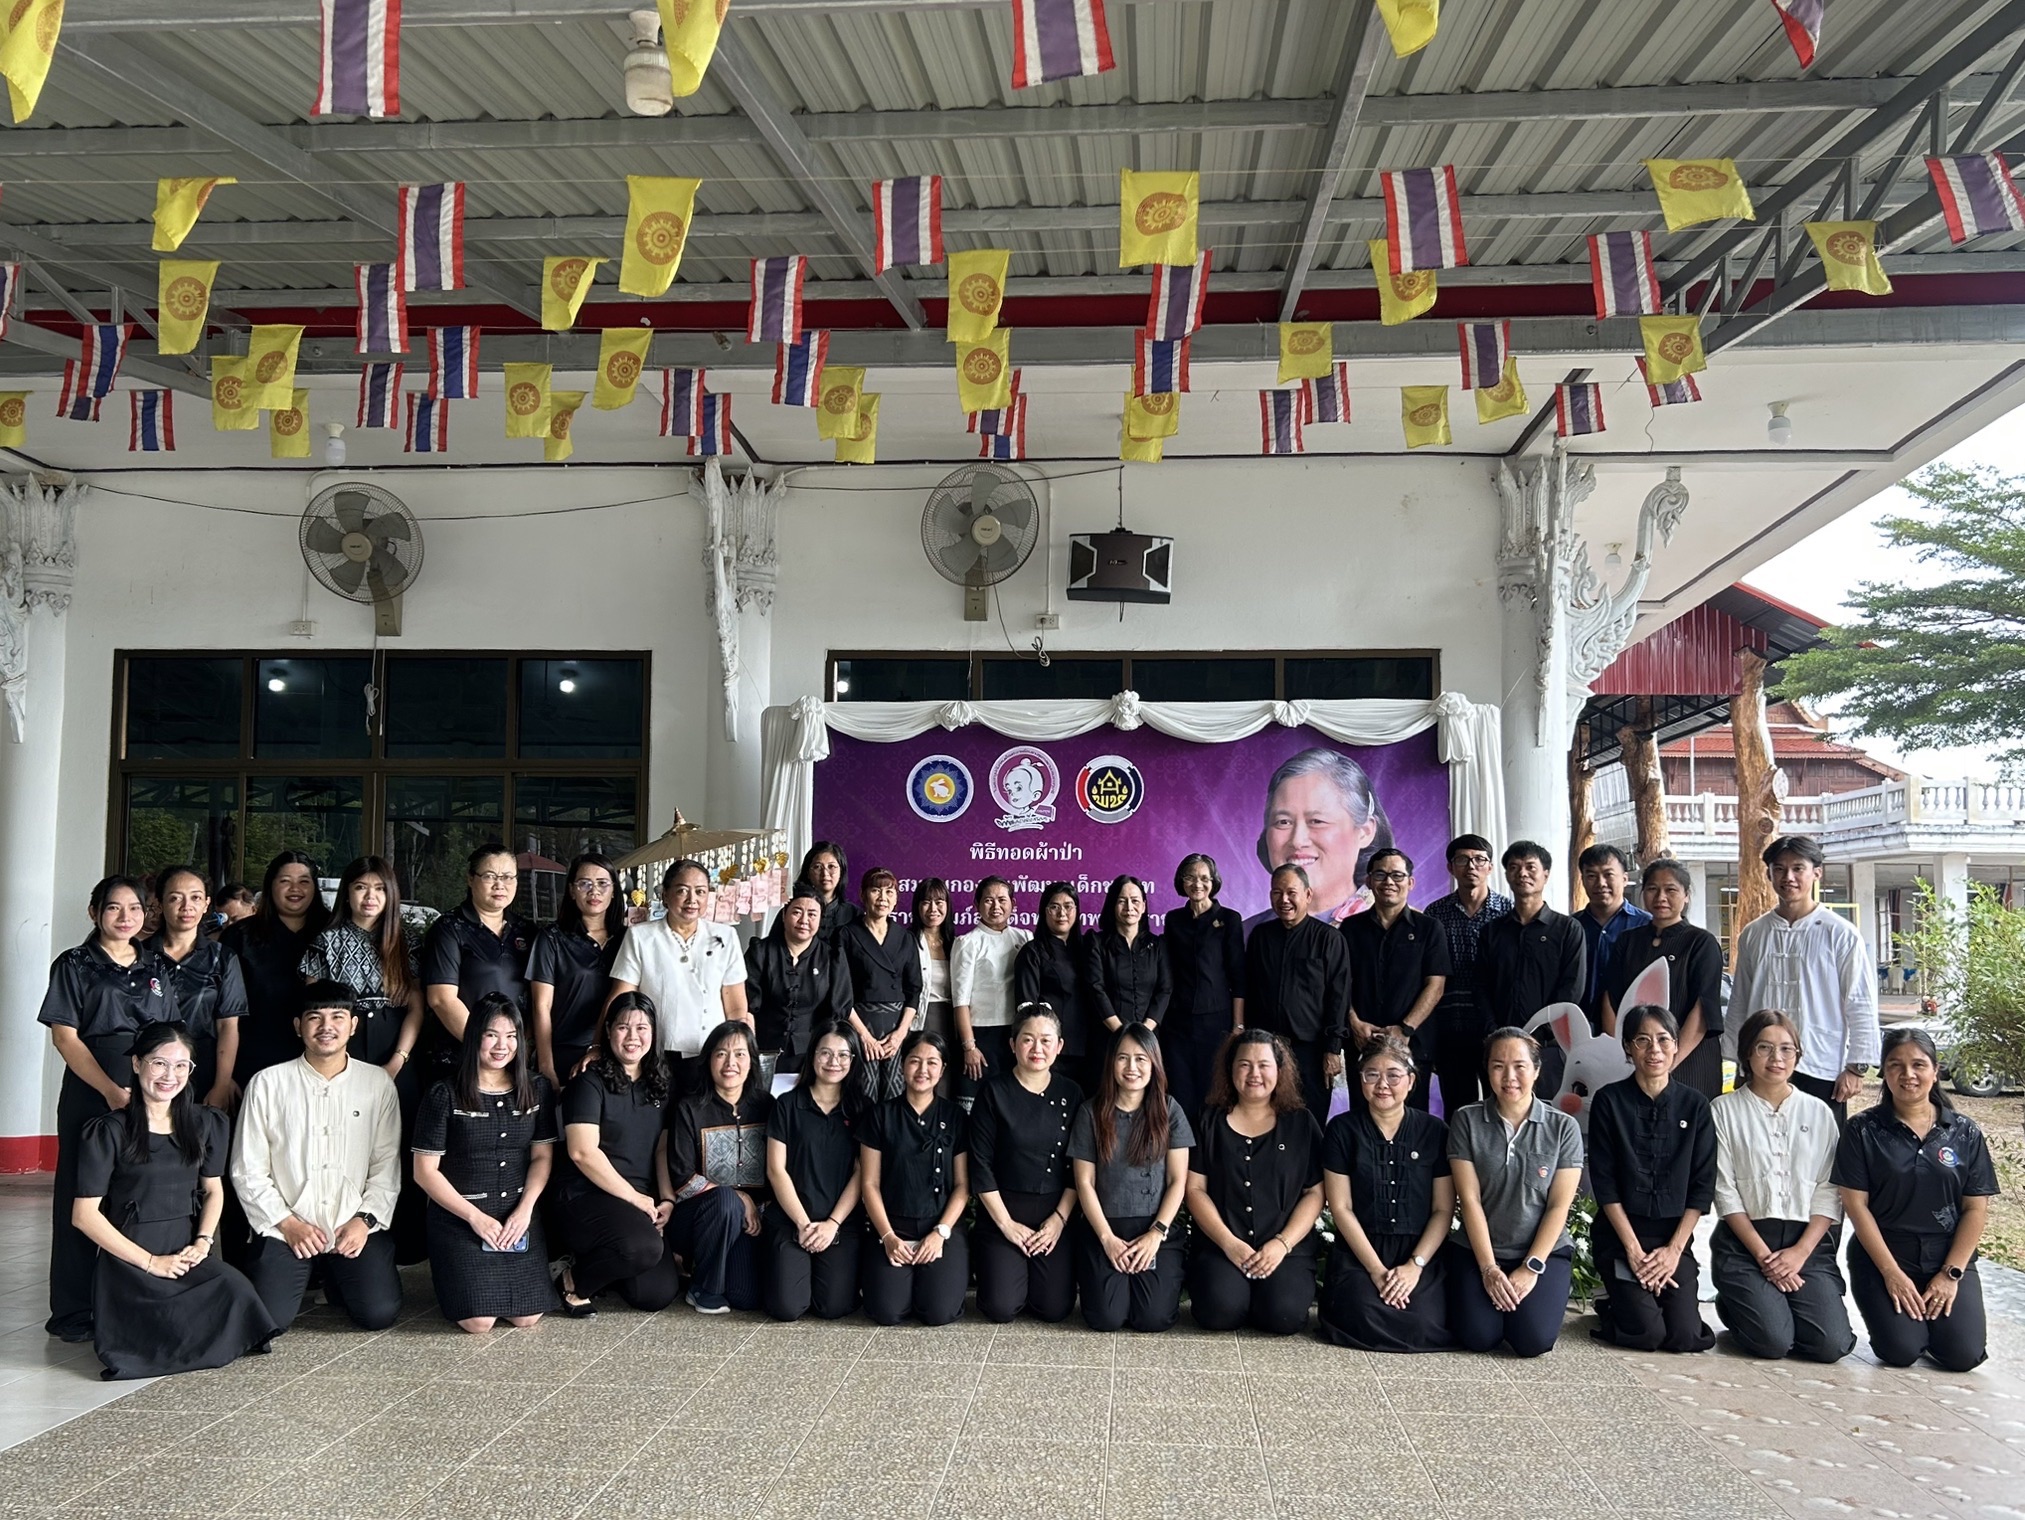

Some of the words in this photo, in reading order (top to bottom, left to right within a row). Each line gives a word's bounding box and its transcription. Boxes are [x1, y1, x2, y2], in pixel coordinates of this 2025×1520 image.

[969, 841, 1083, 861] พิธีทอดผ้าป่า
